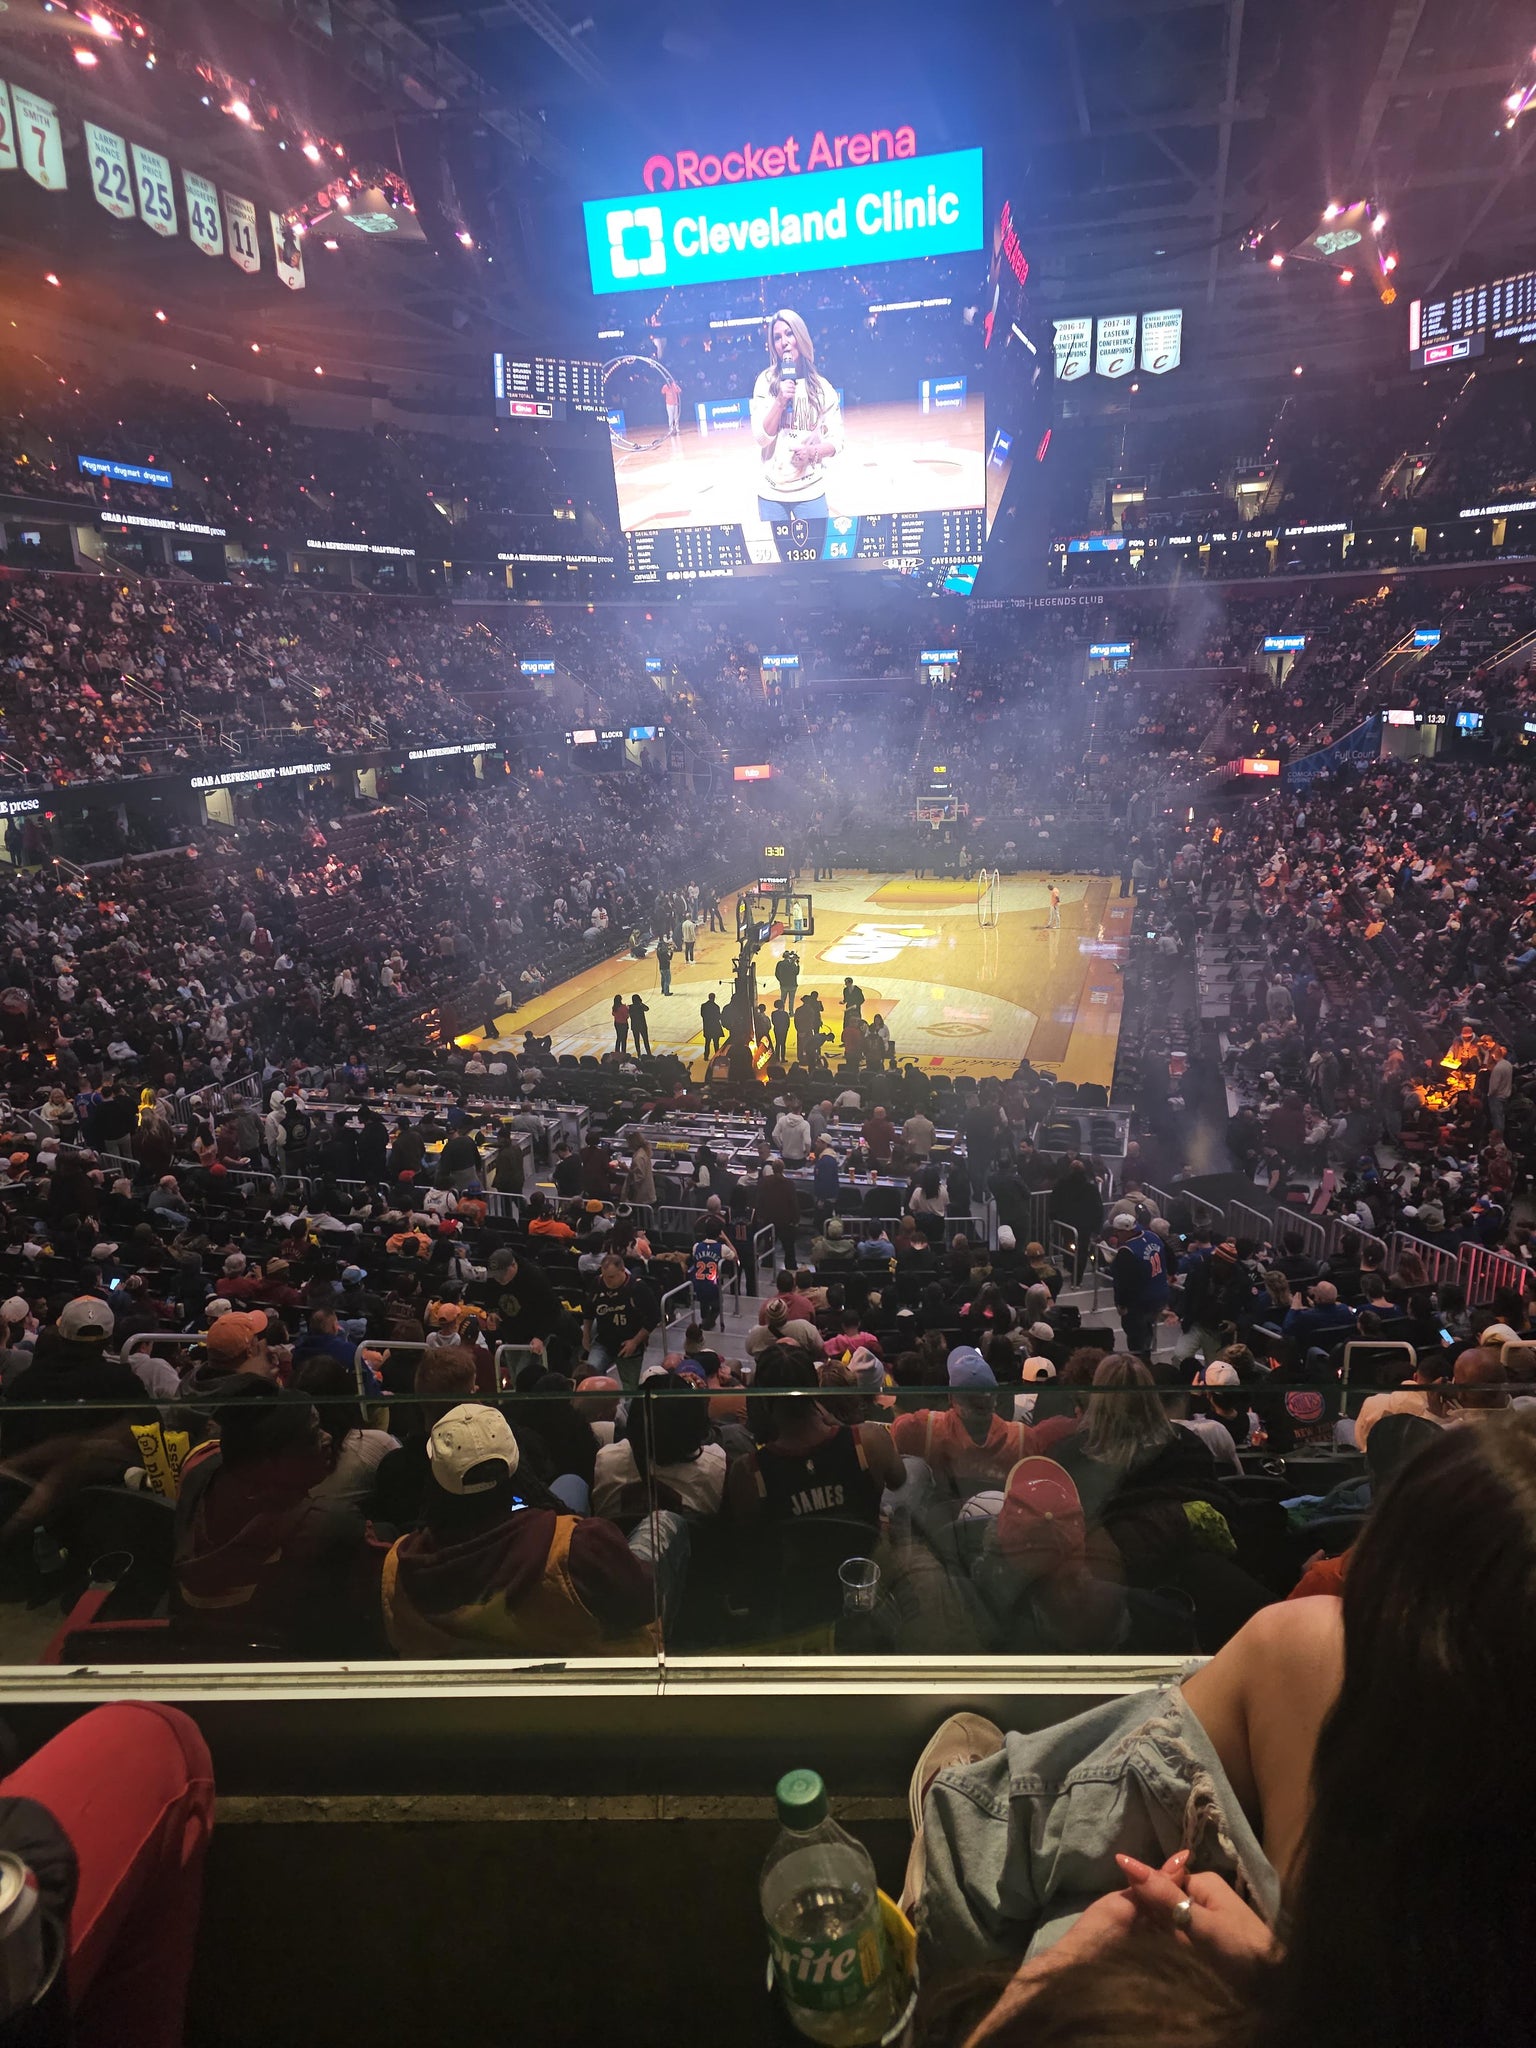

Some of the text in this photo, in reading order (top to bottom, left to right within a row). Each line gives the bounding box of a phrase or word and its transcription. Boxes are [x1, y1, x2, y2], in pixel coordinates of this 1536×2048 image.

[23, 108, 50, 128] SMITH
[93, 130, 118, 148] LARRY
[31, 125, 46, 168] 7
[94, 141, 121, 161] NANCE
[676, 126, 916, 189] Rocket Arena
[95, 156, 130, 204] 22
[141, 177, 173, 221] 25
[192, 200, 218, 242] 43
[673, 197, 847, 257] Cleveland
[855, 184, 959, 235] Clinic
[233, 221, 255, 259] 11
[1059, 322, 1086, 332] 2016-17
[1103, 319, 1131, 329] 2017-18
[1144, 319, 1179, 330] CHAMPIONS
[1103, 329, 1130, 339] EASTERN
[1098, 337, 1134, 347] CONFERENCE
[1100, 347, 1132, 356] CHAMPIONS
[114, 466, 127, 477] drug
[101, 512, 121, 523] GRAB
[122, 515, 127, 524] A
[128, 515, 175, 530] REFRESHMENT
[179, 522, 210, 534] HALFTIME
[777, 526, 788, 535] 3Q
[307, 540, 322, 548] GRAB
[1054, 544, 1066, 552] 3Q
[1079, 542, 1089, 551] 54
[1169, 536, 1191, 544] FOULS
[1197, 535, 1203, 543] 0
[1232, 532, 1237, 540] 5
[787, 549, 816, 560] 13:30
[830, 542, 847, 557] 54
[1034, 595, 1104, 607] LEGENDS CLUB
[1264, 637, 1305, 649] drug mart
[920, 651, 958, 661] drug mart
[1090, 645, 1130, 656] drug mart
[762, 656, 799, 666] drug mart
[520, 663, 537, 672] drug
[1428, 715, 1446, 724] 13:30
[602, 731, 623, 739] BLOCKS
[1334, 750, 1375, 760] Full Court
[190, 762, 330, 788] GRAB A REFRESHMENT HALFTIME prese
[9, 799, 39, 815] prese
[765, 846, 785, 857] 13:30
[695, 1261, 718, 1281] 23
[613, 1313, 627, 1326] 45
[790, 1484, 844, 1516] JAMES
[776, 1947, 857, 1984] rite
